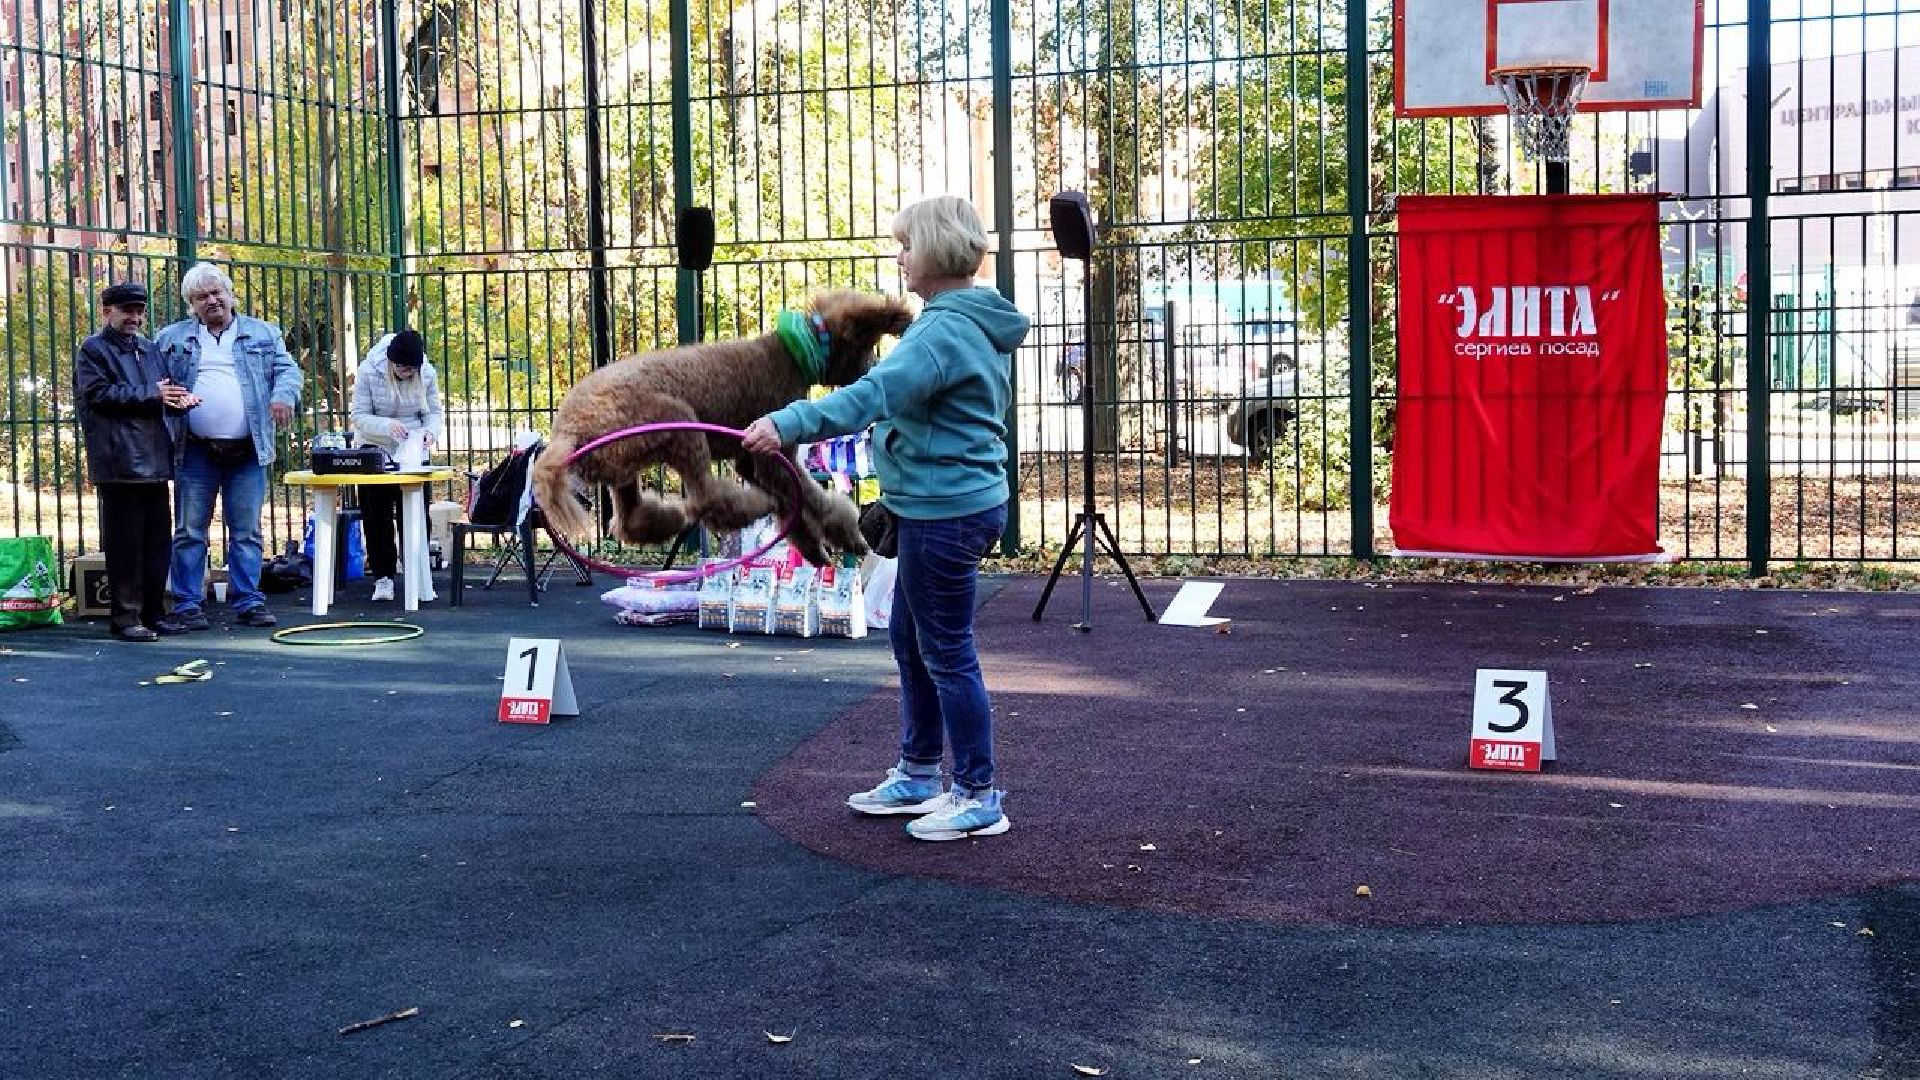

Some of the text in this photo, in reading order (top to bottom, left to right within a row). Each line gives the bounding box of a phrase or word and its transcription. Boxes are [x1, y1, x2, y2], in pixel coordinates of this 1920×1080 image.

[1781, 95, 1920, 126] ЦНТРАЬНЫ
[1454, 342, 1600, 360] сергиев посад
[519, 646, 539, 691] 1
[1487, 680, 1529, 733] 3
